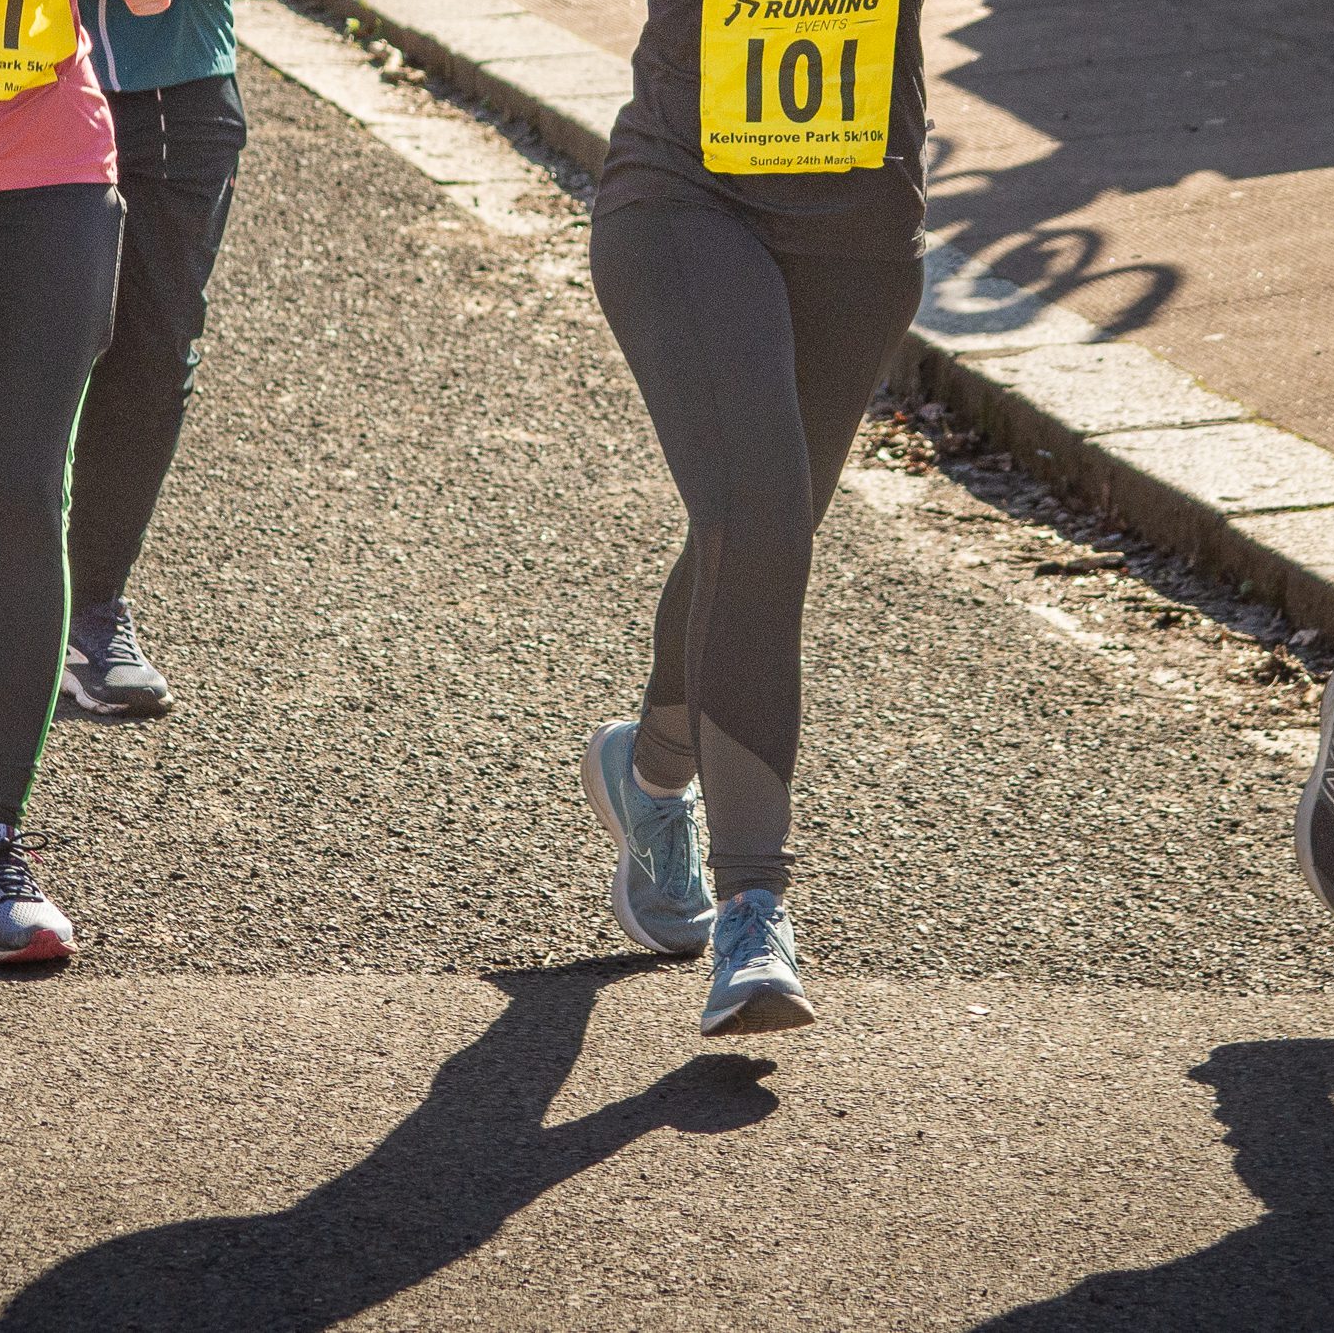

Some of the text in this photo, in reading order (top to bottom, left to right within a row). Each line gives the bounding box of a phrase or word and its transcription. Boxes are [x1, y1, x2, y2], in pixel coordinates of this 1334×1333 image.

[795, 18, 848, 33] EVENTS
[746, 38, 859, 123] 101
[709, 130, 884, 146] Kelvingrove Park 5k/10k
[750, 155, 857, 167] Sunday 24th March
